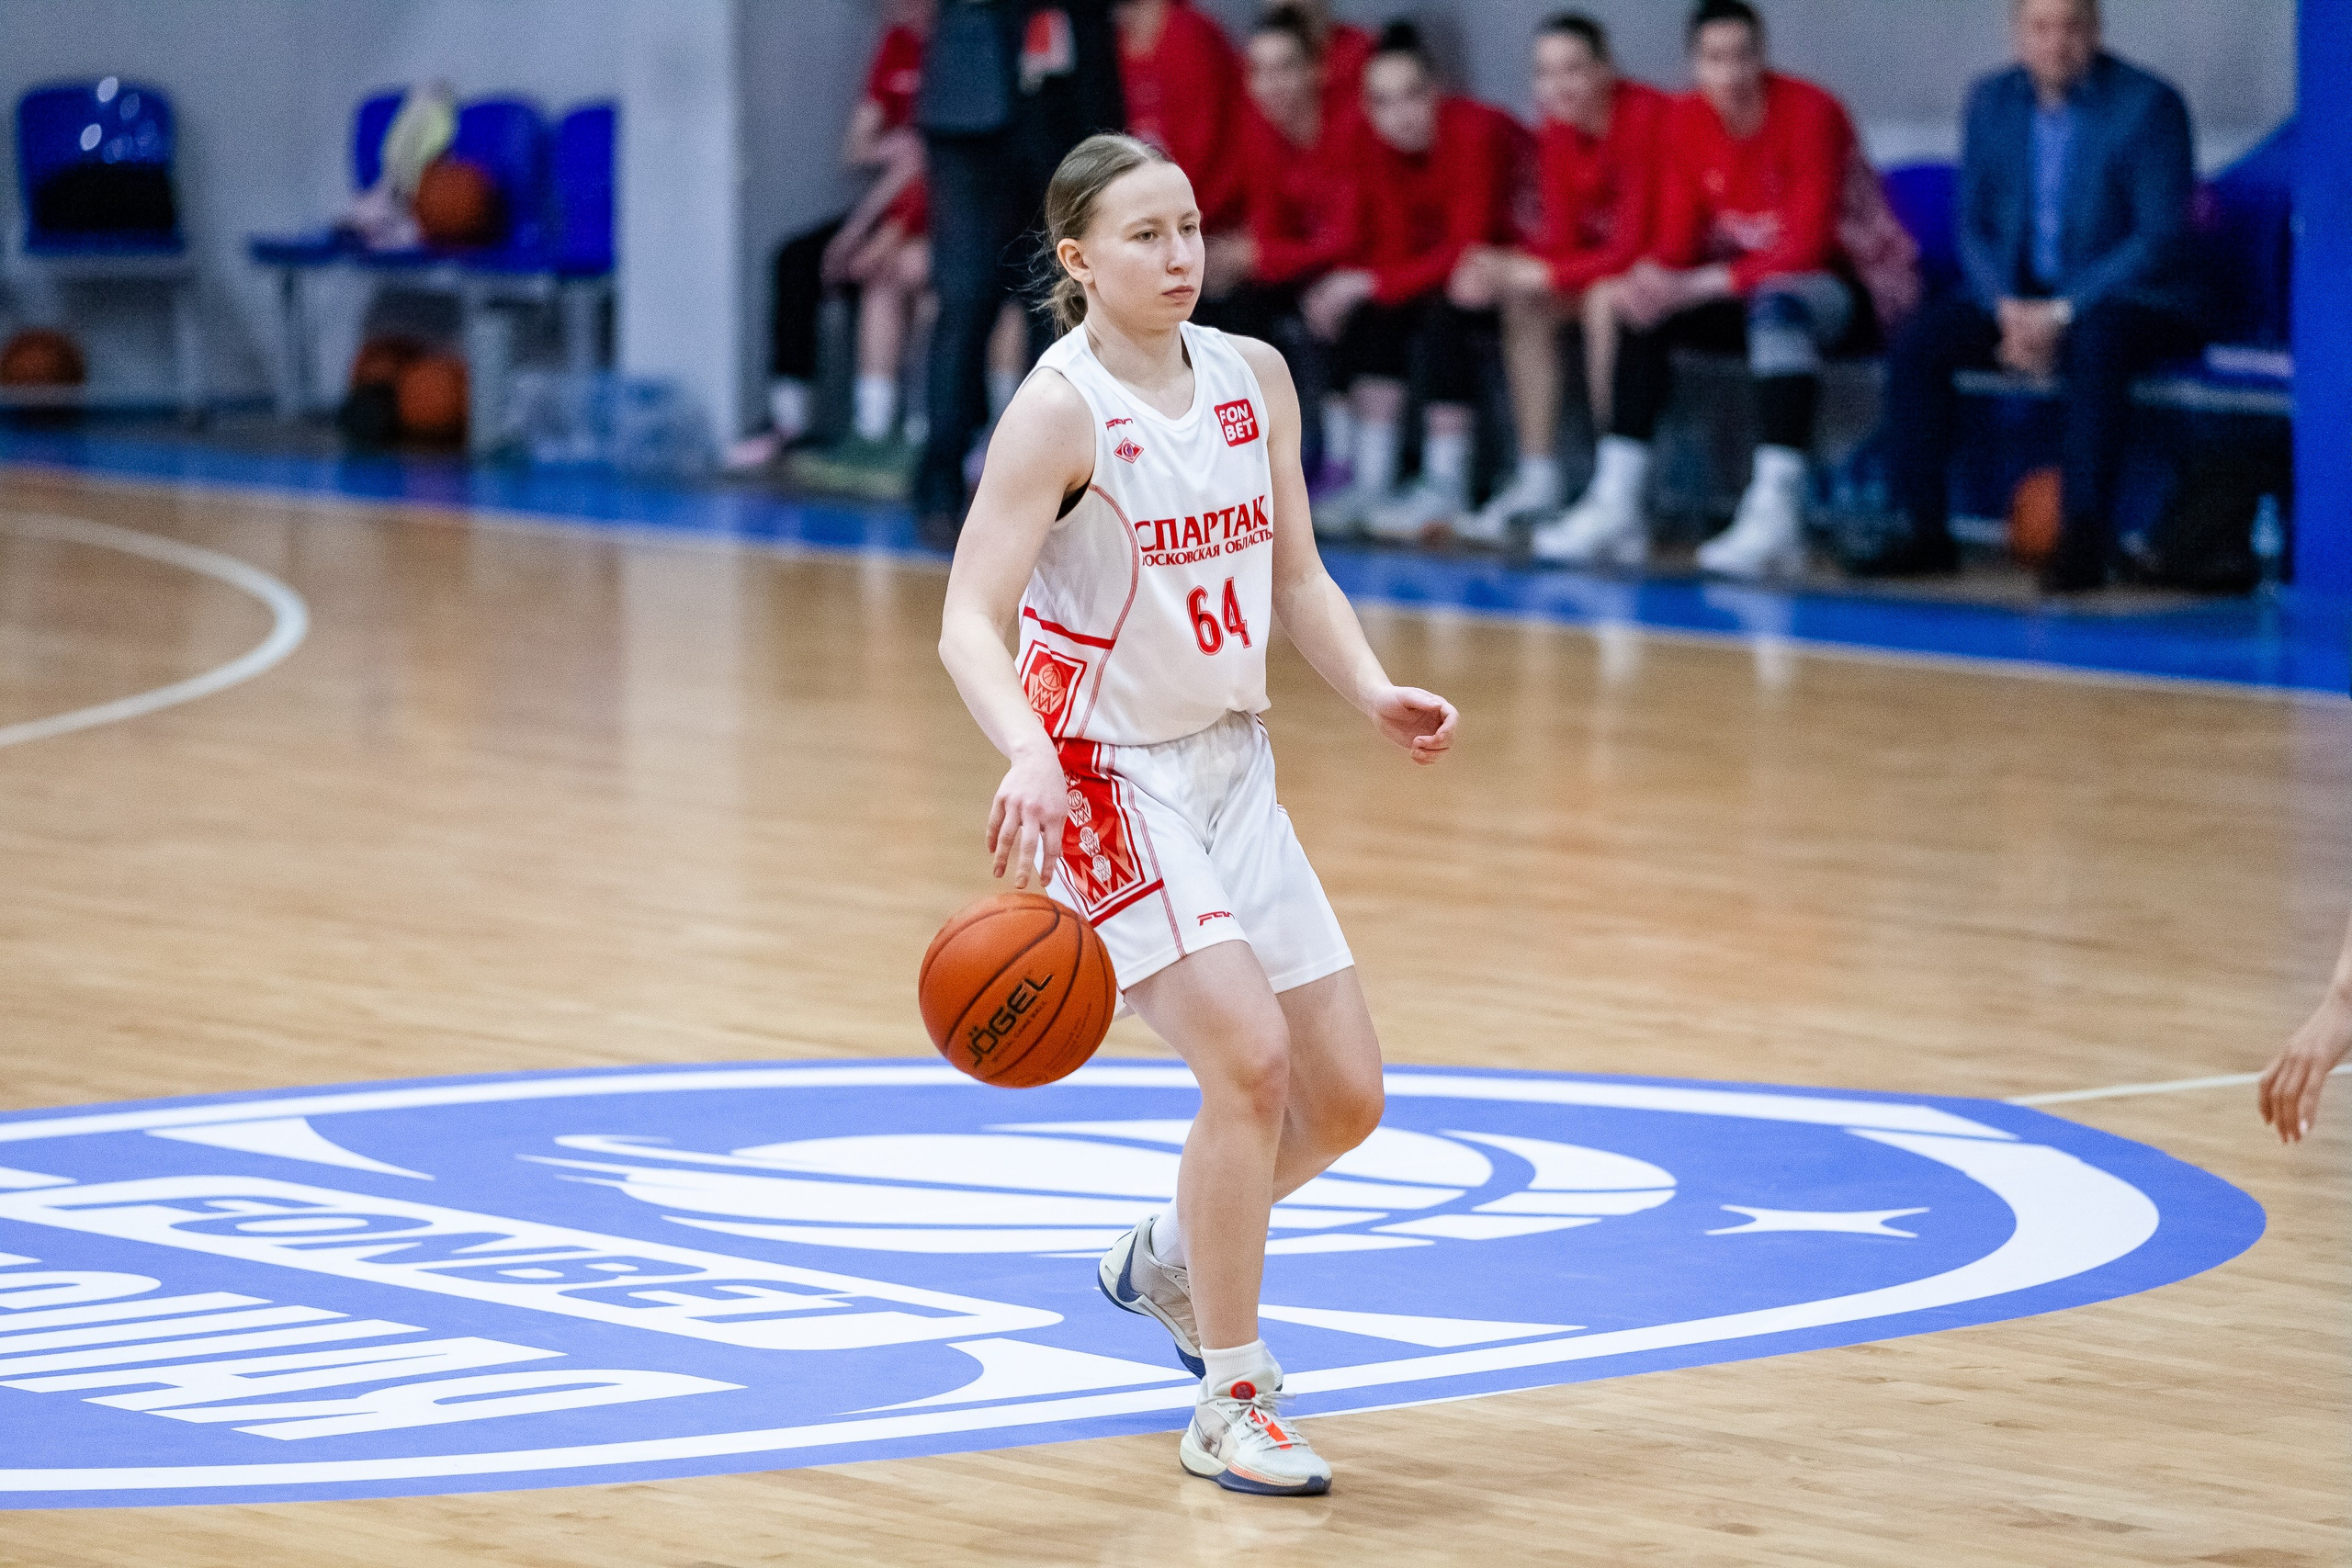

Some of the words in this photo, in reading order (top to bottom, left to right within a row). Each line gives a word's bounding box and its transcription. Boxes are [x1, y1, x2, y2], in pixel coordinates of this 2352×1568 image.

[1219, 403, 1249, 425] FON
[1225, 417, 1254, 442] BET
[1134, 494, 1269, 553] СПАРТАК
[1142, 544, 1220, 567] ОСКОВСКАЯ
[1225, 528, 1273, 554] ОБЛАСТЬ
[1186, 576, 1252, 656] 64
[967, 973, 1054, 1068] JÖGEL
[40, 1194, 983, 1325] FONBET
